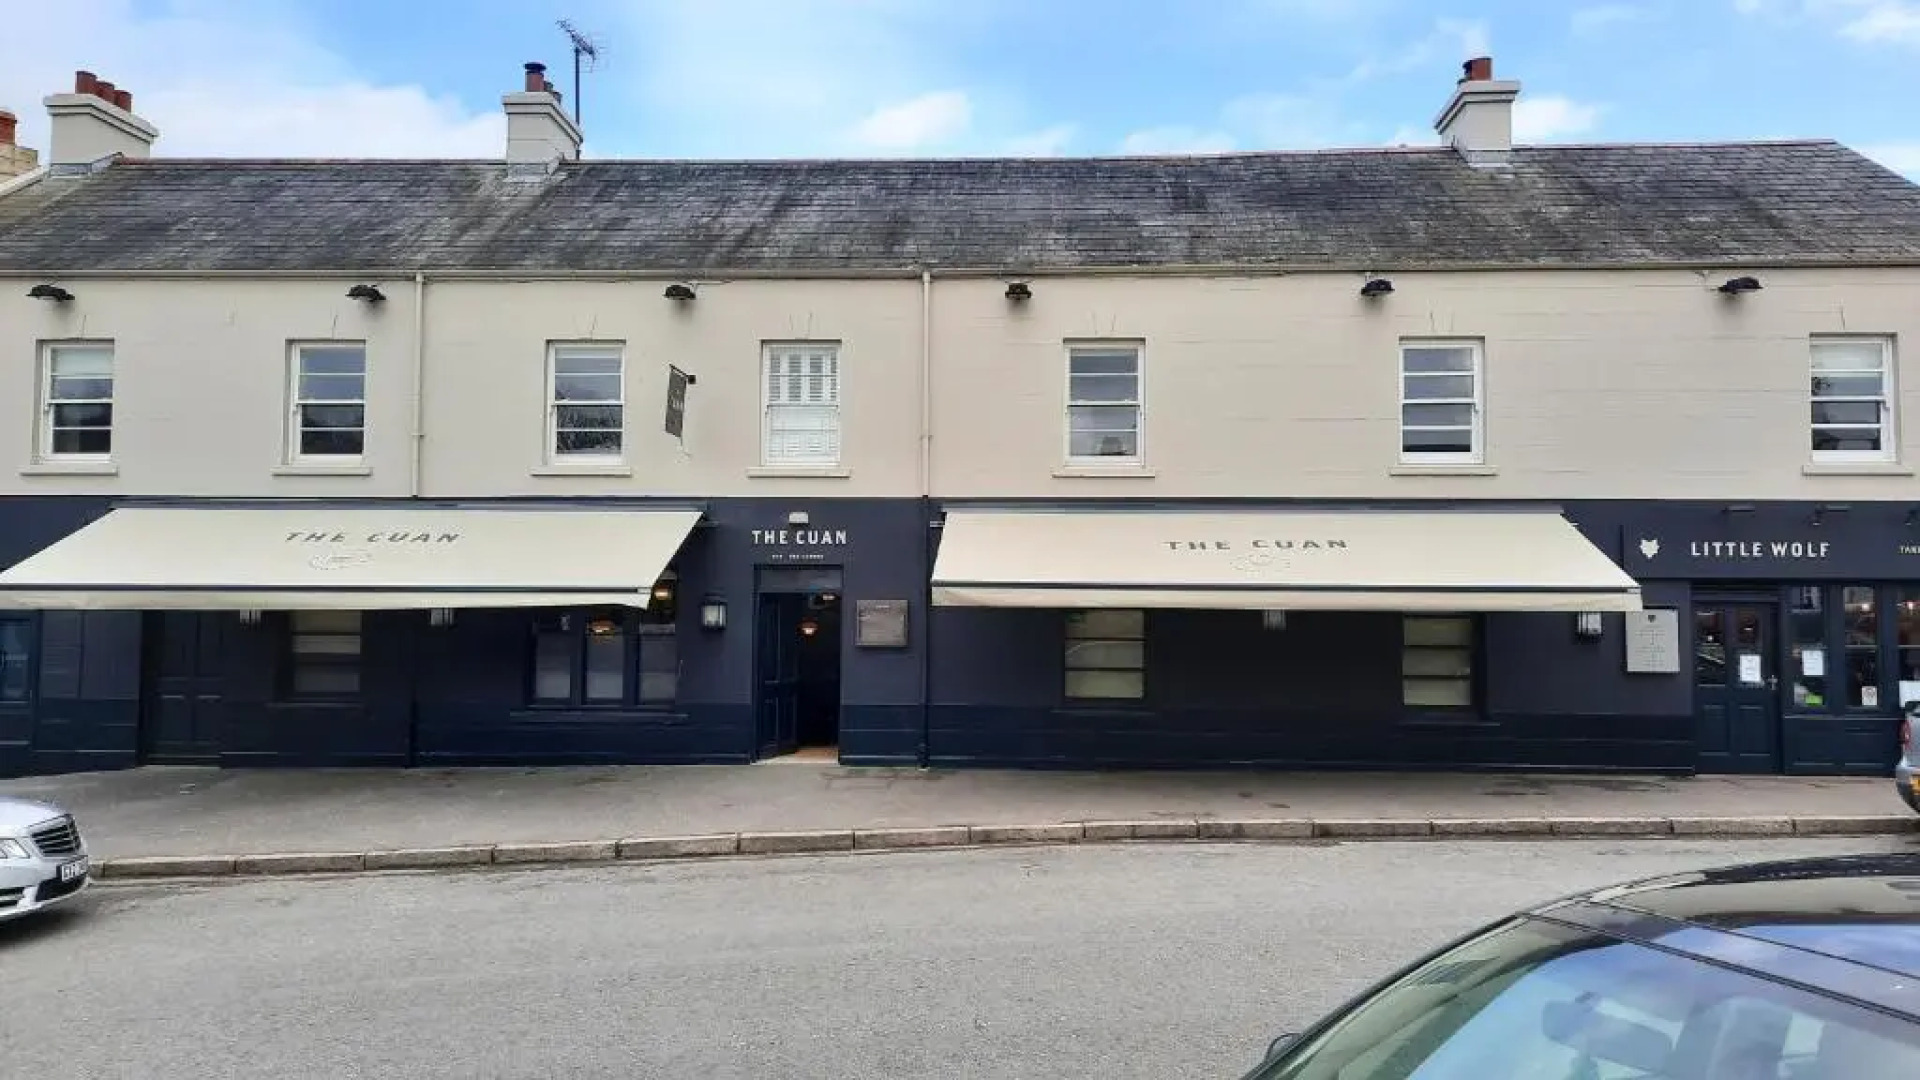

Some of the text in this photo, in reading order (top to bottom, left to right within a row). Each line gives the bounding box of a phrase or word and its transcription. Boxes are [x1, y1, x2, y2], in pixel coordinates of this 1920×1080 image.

[285, 531, 460, 543] THE CUAN
[752, 530, 847, 545] THE CUAN
[1162, 539, 1348, 550] THE CUAN
[1691, 541, 1830, 558] LITTLE WOLF
